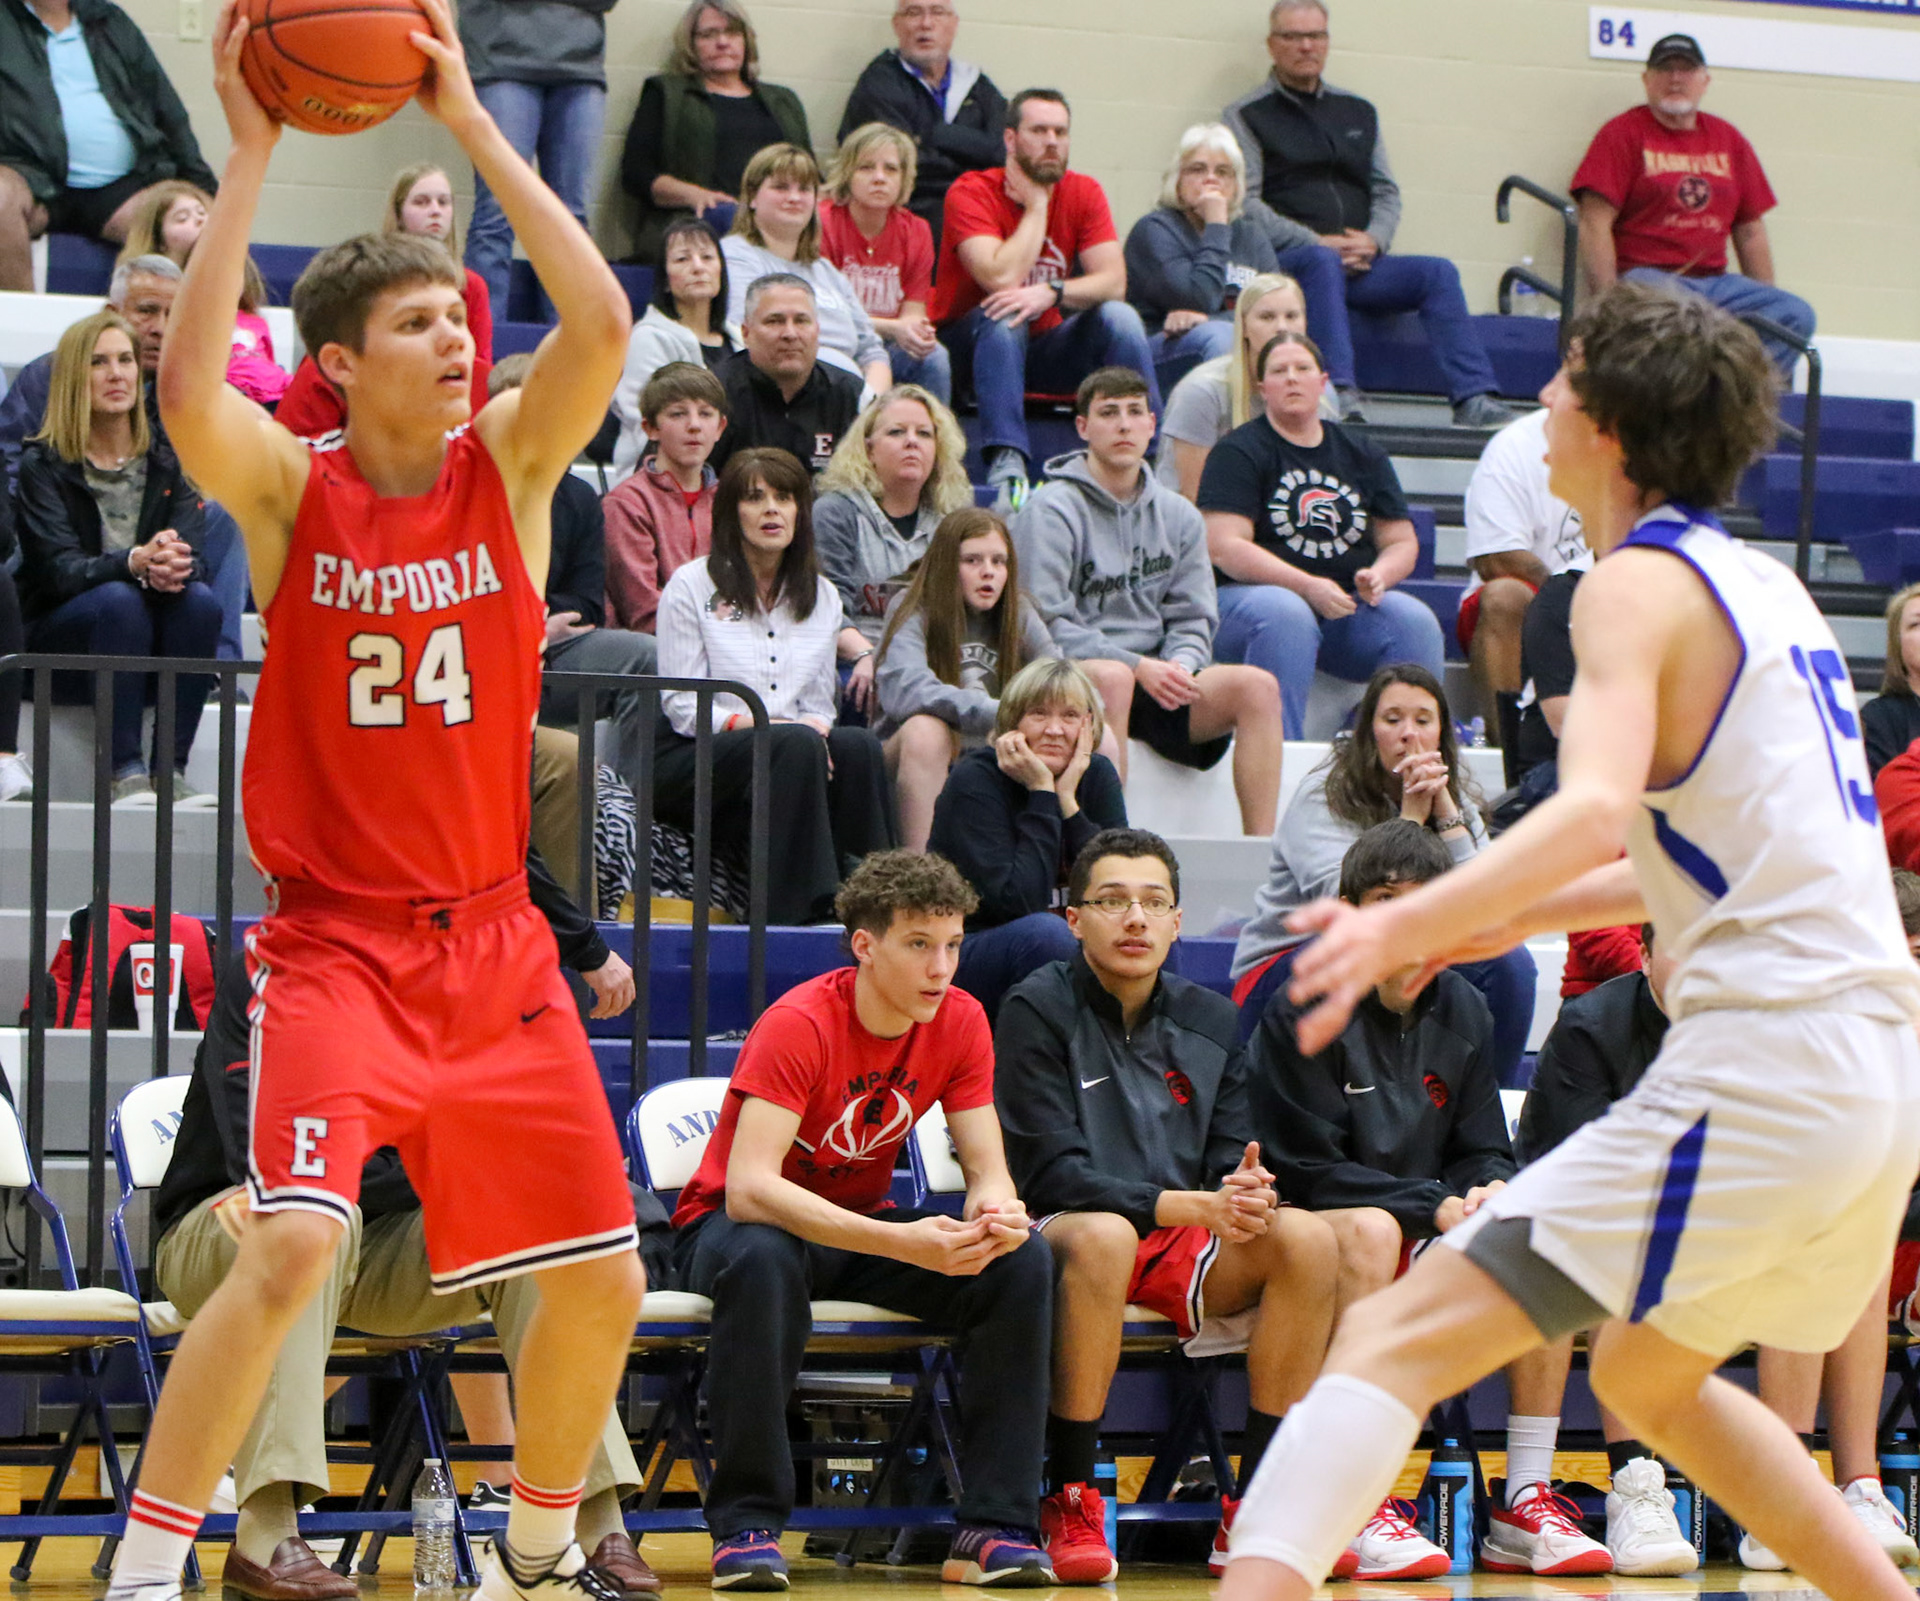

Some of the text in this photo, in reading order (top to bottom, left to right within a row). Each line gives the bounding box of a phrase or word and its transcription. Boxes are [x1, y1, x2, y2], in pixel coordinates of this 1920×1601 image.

[1599, 19, 1635, 47] 84
[814, 433, 833, 456] E
[311, 542, 503, 616] EMPORIA
[348, 622, 473, 727] 24
[1789, 645, 1877, 827] 15
[290, 1116, 328, 1178] E
[666, 1110, 721, 1148] AND
[1439, 1480, 1449, 1550] OWERADE
[1910, 1474, 1918, 1539] OWERADE
